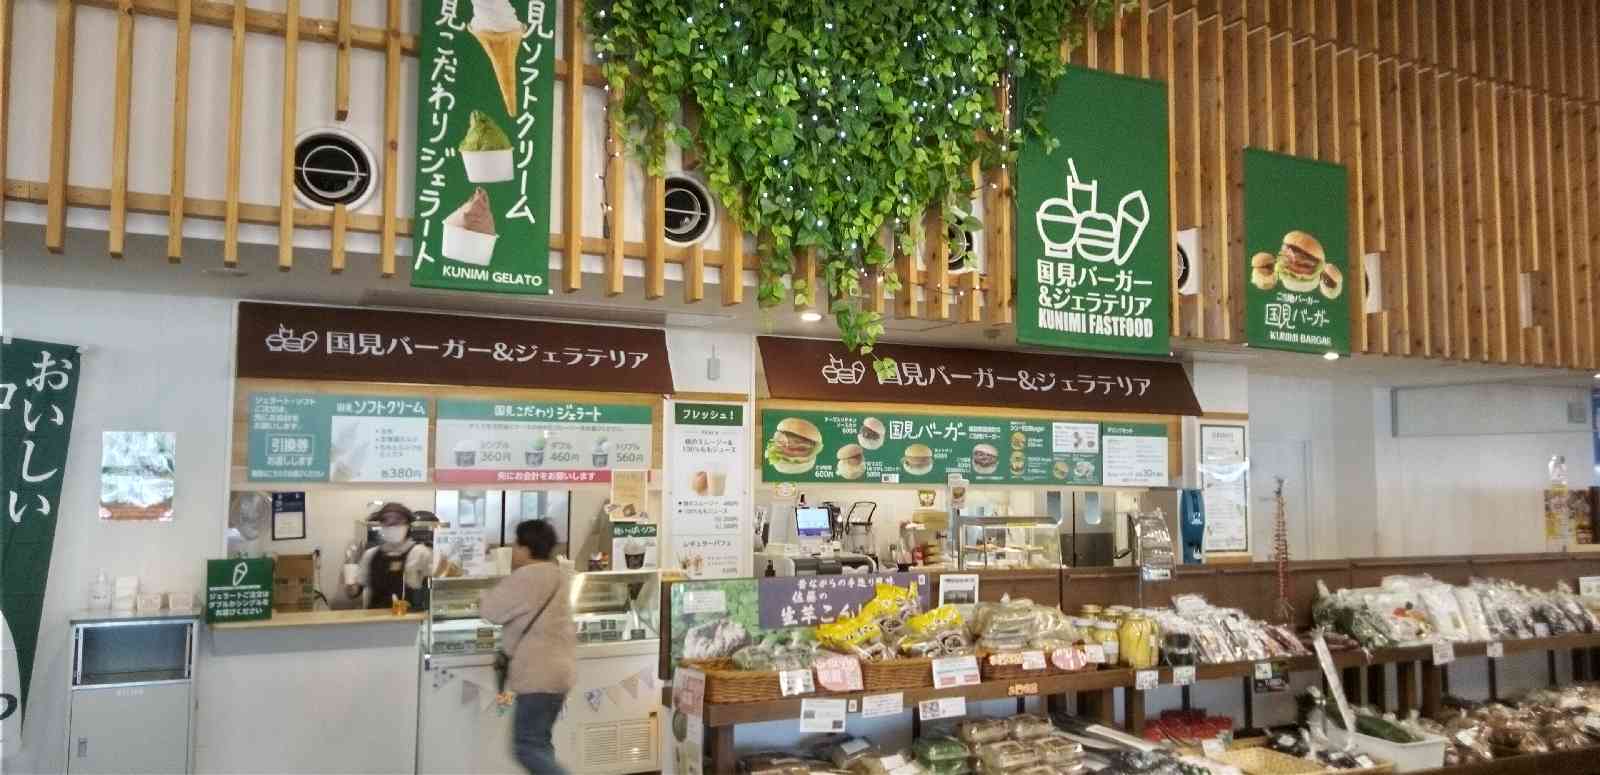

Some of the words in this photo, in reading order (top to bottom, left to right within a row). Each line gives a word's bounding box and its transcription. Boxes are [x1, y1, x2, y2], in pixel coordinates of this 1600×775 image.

[442, 265, 489, 282] KUNIMI
[492, 271, 543, 286] GELATO
[1036, 258, 1153, 293] 国見バーガー
[1038, 285, 1152, 317] &ジェラテリア
[1038, 307, 1087, 334] KUNIMI
[1088, 314, 1154, 338] FASTFOOD
[1264, 303, 1330, 330] 国見バーガー
[1270, 330, 1298, 343] KUNIMI
[326, 331, 649, 369] 国見バーガー&ジェラテリア
[9, 350, 73, 523] おいしい
[889, 419, 967, 442] 国見バーガー
[480, 450, 512, 462] 360円
[550, 451, 580, 462] 460円
[616, 453, 644, 464] 560円
[497, 470, 596, 481] 先にお会計をお願いします
[814, 470, 834, 478] 600円
